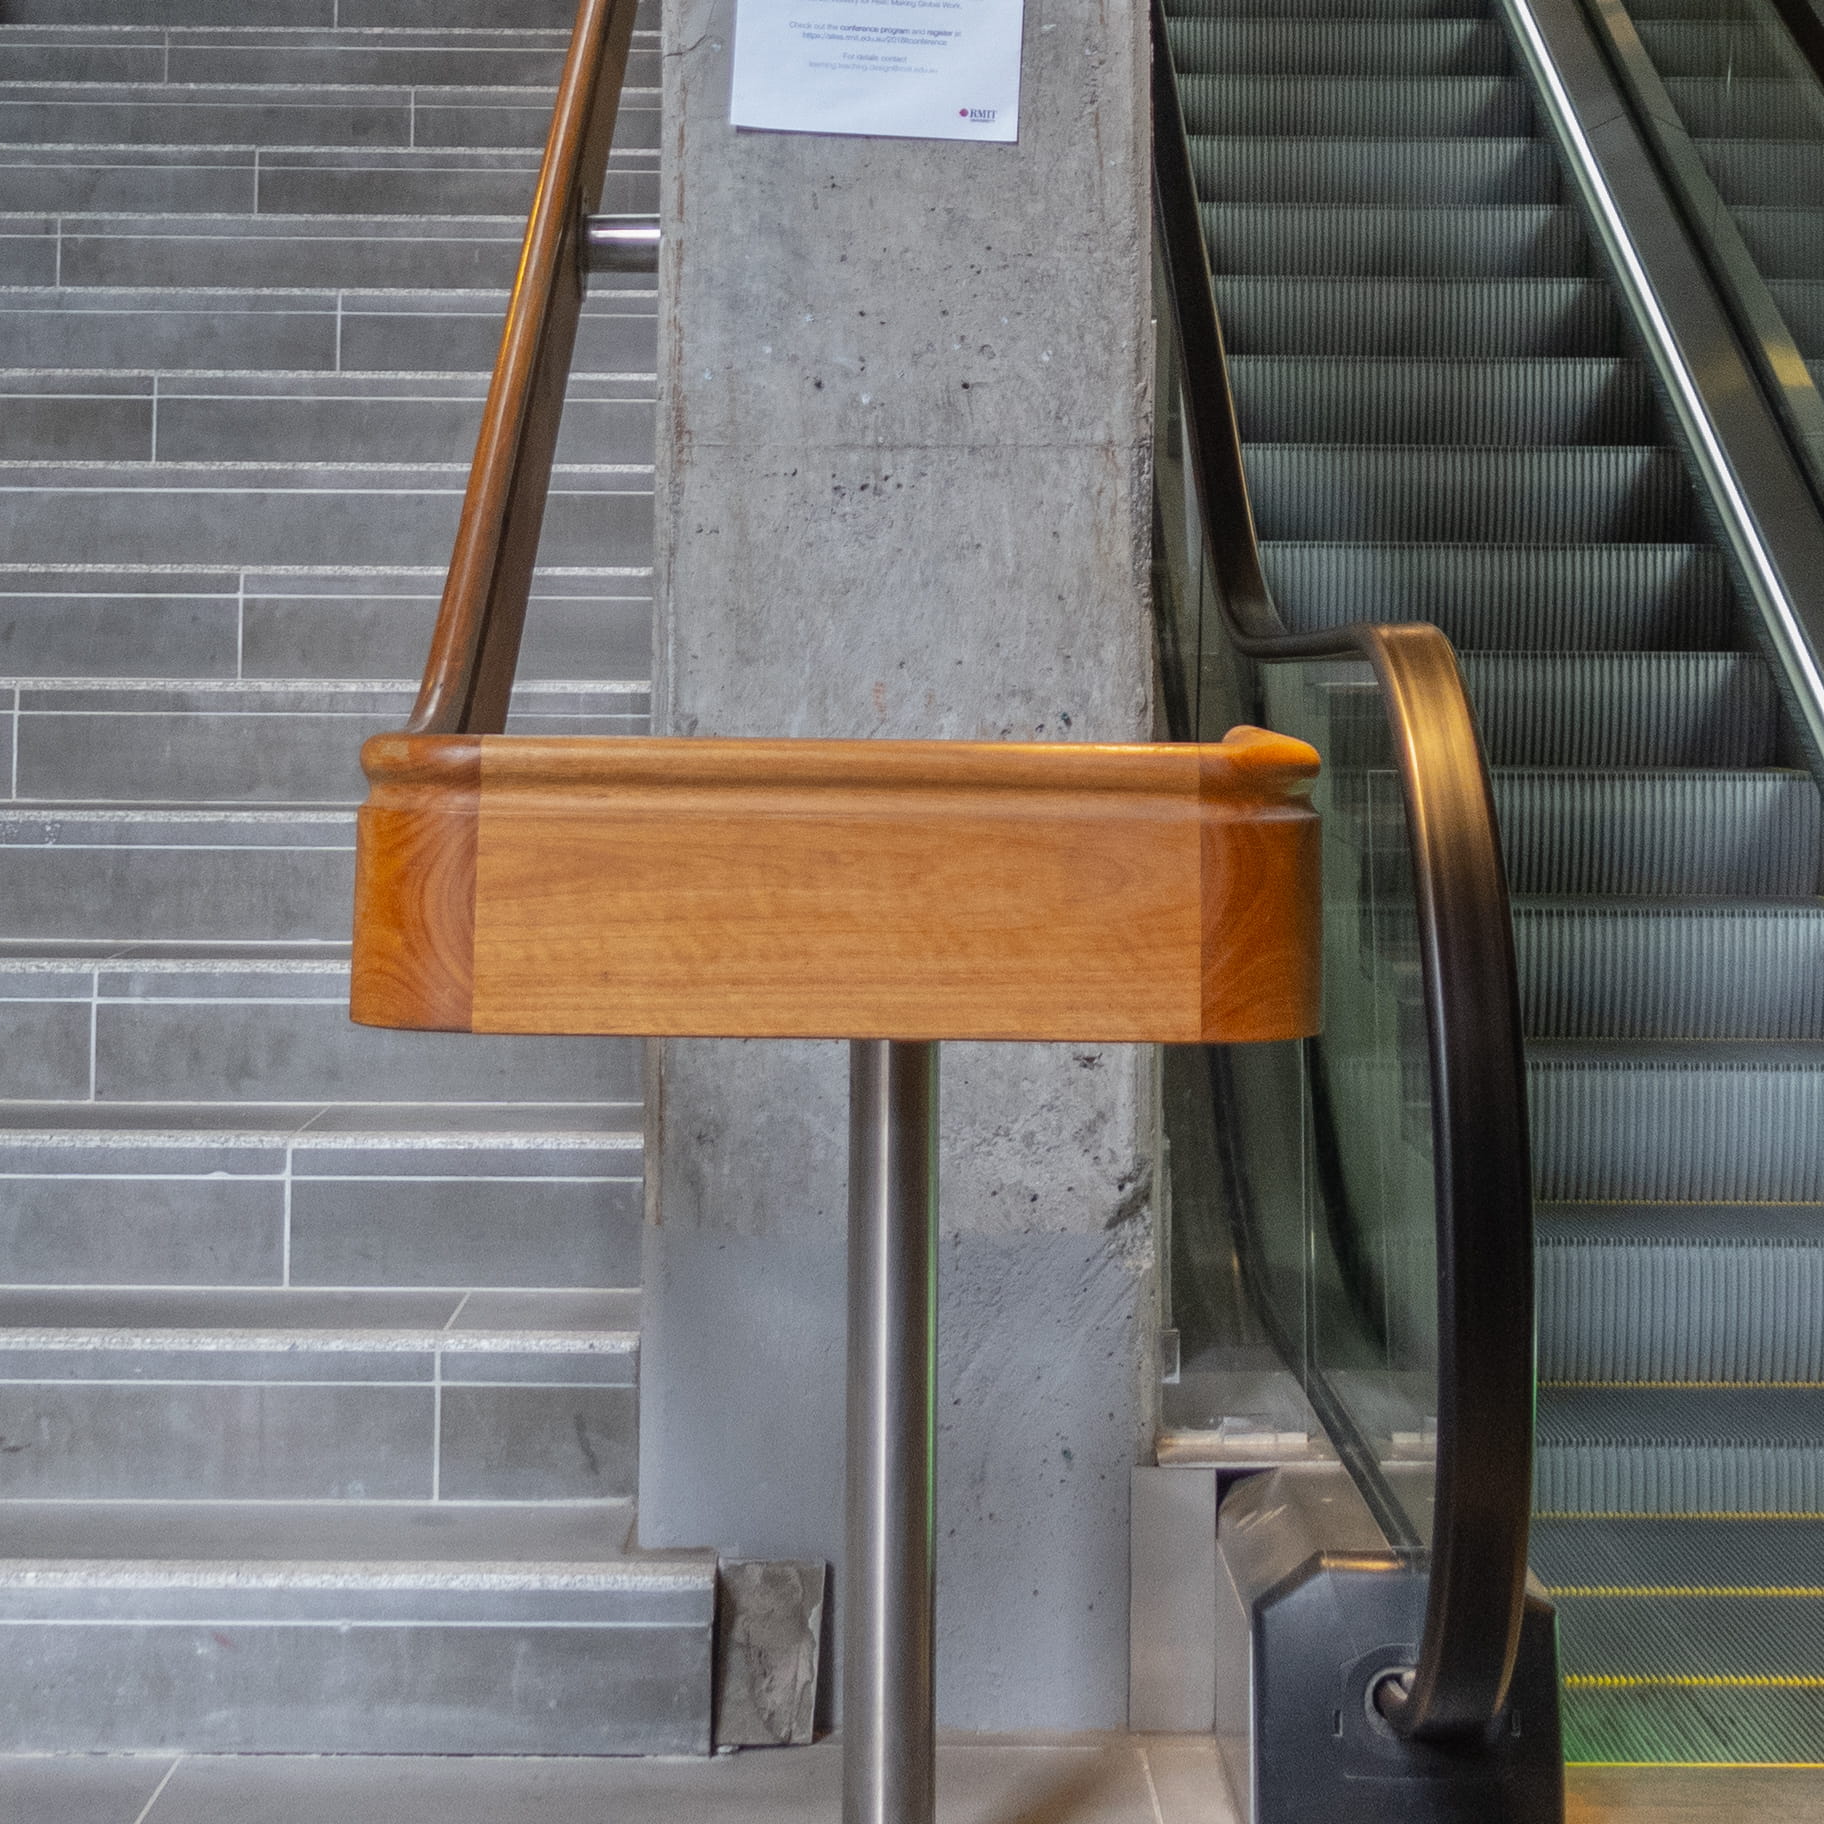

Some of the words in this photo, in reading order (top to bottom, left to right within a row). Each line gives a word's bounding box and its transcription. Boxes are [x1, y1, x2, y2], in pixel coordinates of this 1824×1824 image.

[789, 21, 812, 29] Check
[840, 24, 878, 32] conference
[880, 27, 909, 35] program
[927, 28, 952, 37] register
[970, 109, 997, 119] RMIT
